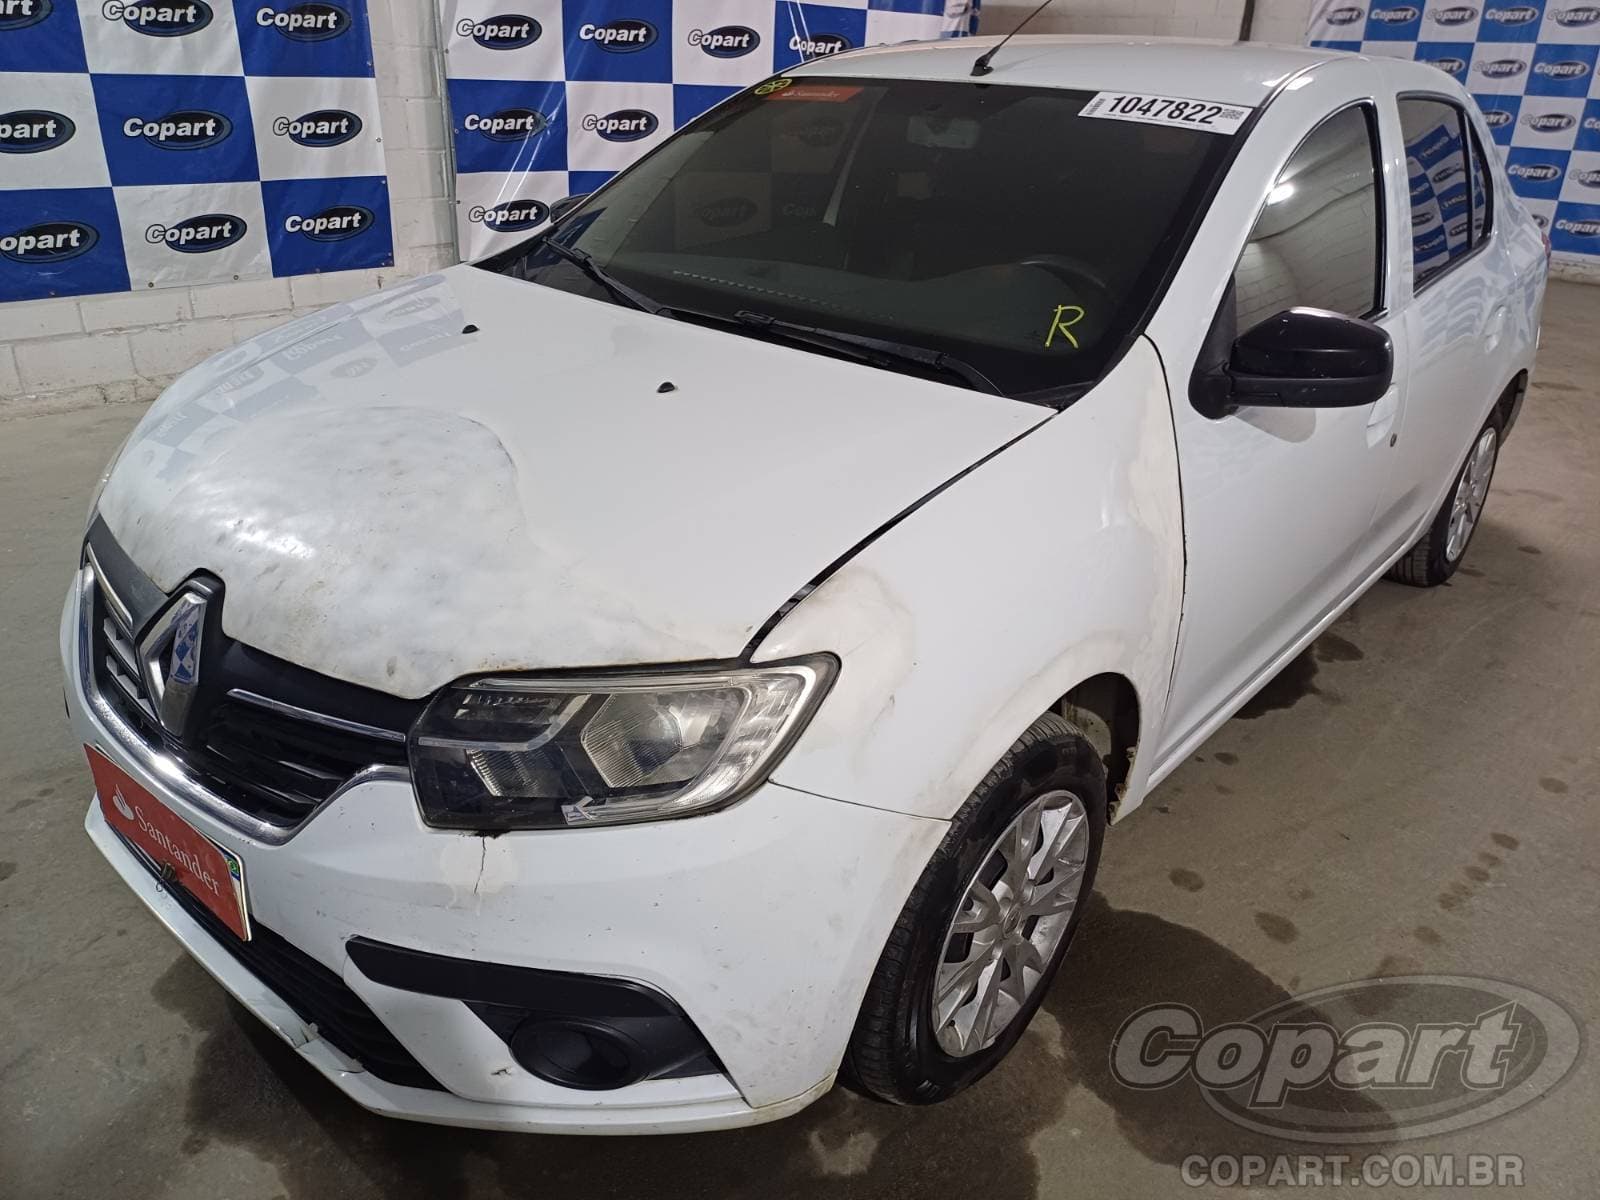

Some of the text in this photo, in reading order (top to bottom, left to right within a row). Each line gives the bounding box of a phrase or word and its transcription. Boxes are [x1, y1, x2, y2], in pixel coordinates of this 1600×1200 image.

[103, 0, 197, 24] Copart
[256, 8, 338, 30] Copart
[1371, 8, 1414, 22] Copart
[1426, 8, 1471, 22] Copart
[1485, 9, 1533, 22] Copart
[1547, 9, 1597, 23] Copart
[457, 19, 530, 41] Copart
[579, 24, 647, 44] Copart
[687, 29, 750, 49] Copart
[788, 37, 842, 54] Copart
[1473, 61, 1520, 74] Copart
[1534, 62, 1584, 77] Copart
[1109, 96, 1222, 124] 1047822
[123, 117, 216, 141] Copart
[272, 116, 349, 137] Copart
[465, 114, 534, 135] Copart
[582, 114, 647, 134] Copart
[1519, 113, 1568, 128] Copart
[1508, 164, 1556, 179] Copart
[285, 210, 362, 233] Copart
[469, 205, 538, 226] Copart
[145, 221, 232, 245] Copart
[1045, 305, 1085, 348] R
[134, 805, 219, 896] Santander
